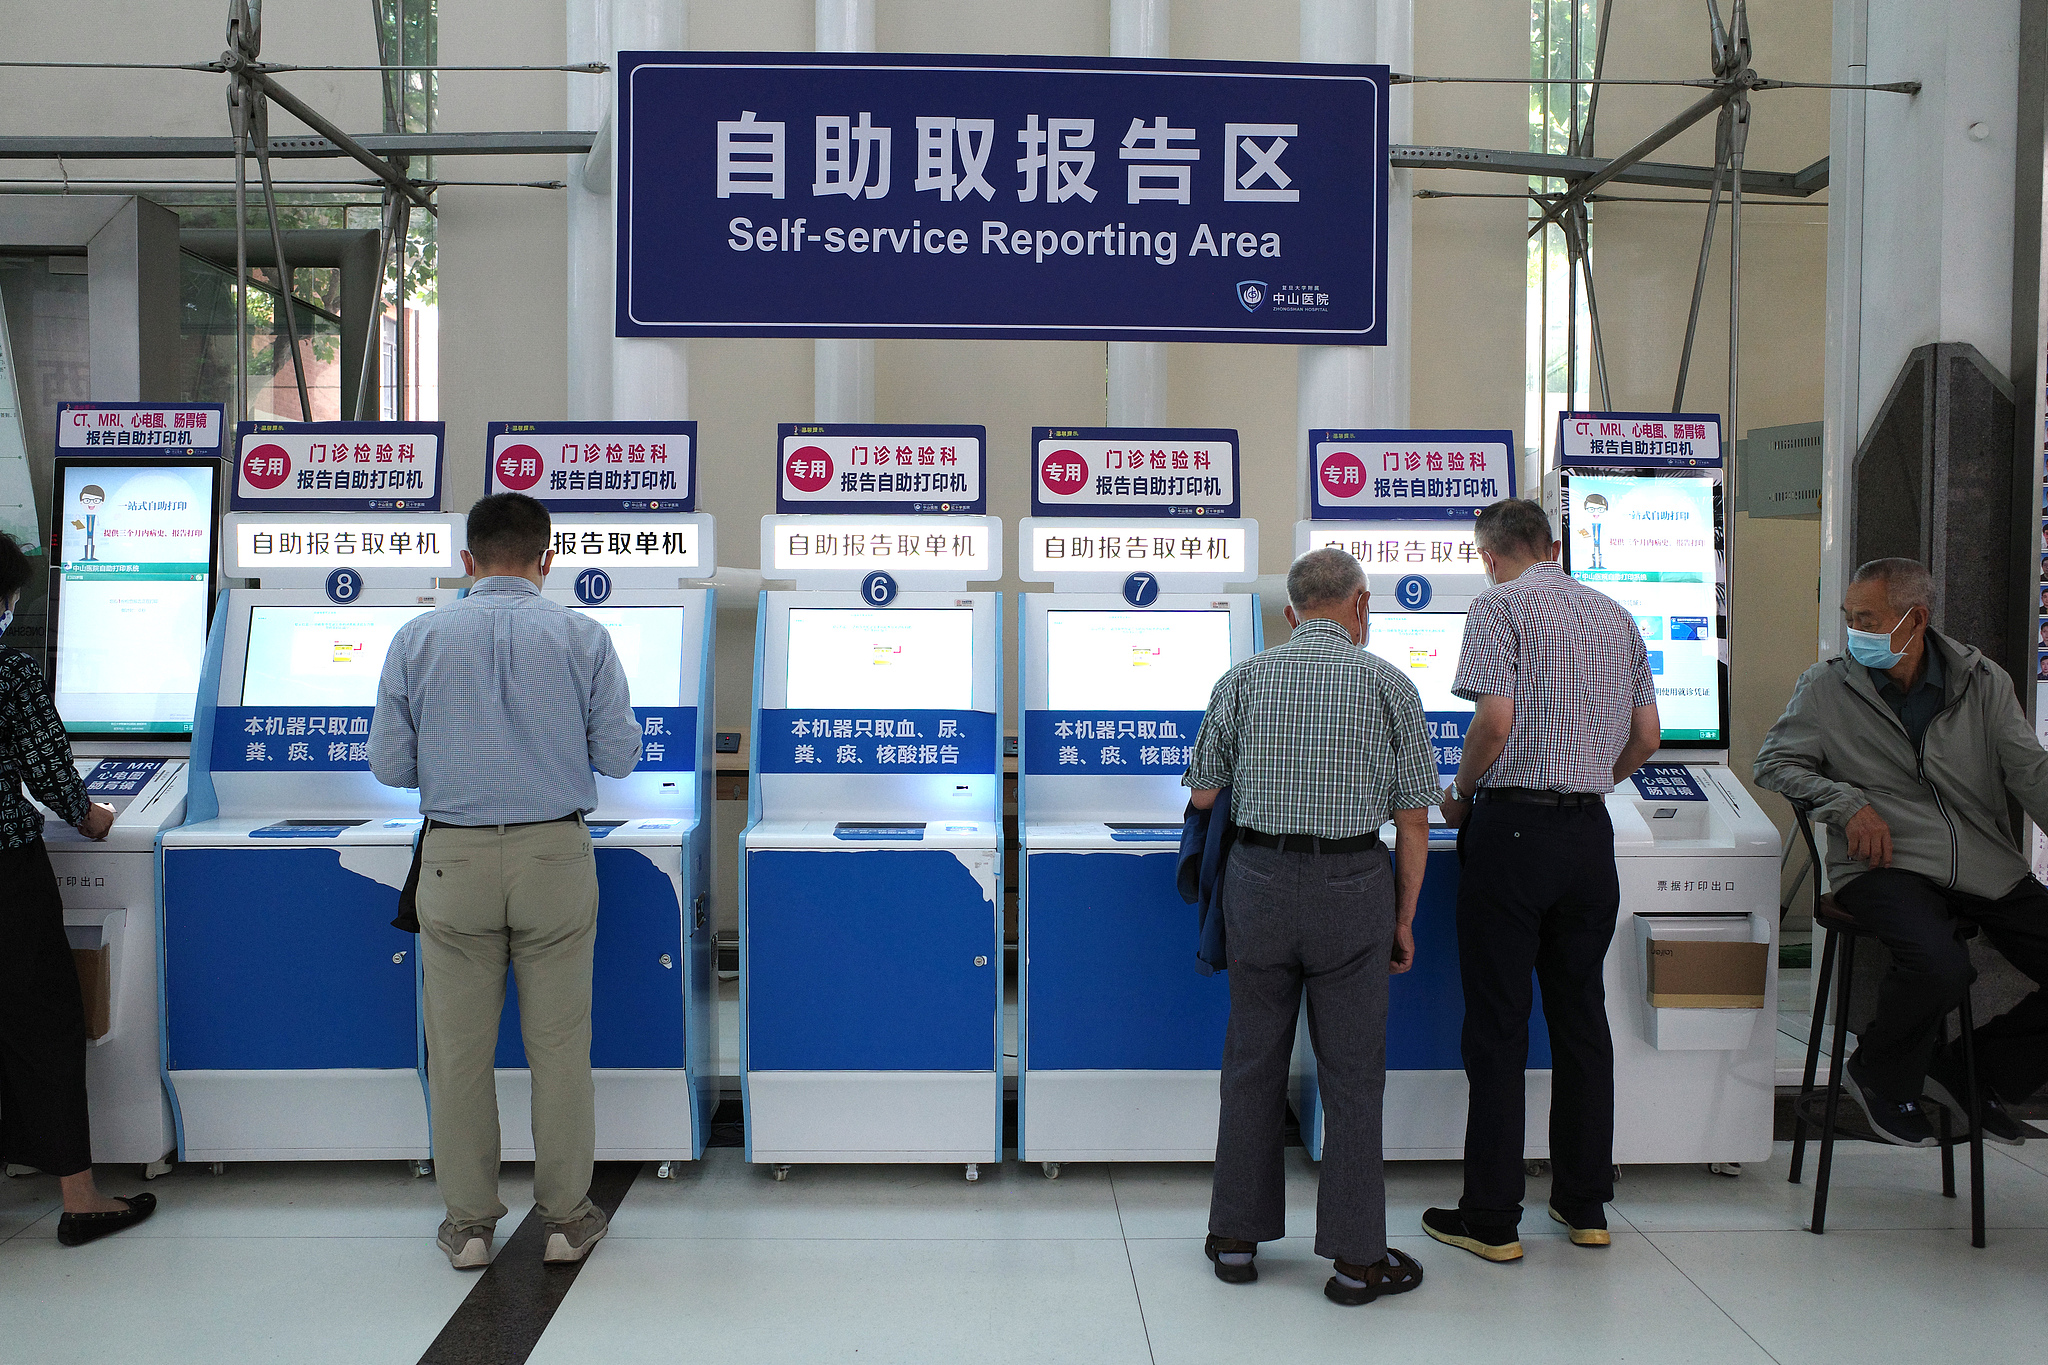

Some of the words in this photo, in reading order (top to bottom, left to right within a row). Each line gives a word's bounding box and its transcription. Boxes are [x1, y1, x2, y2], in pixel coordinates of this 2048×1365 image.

[715, 110, 1300, 205] 自助取报告区
[728, 217, 968, 254] Self-service
[981, 220, 1178, 265] Reporting
[1189, 223, 1281, 259] Area
[1273, 292, 1329, 306] 中山医院
[73, 413, 207, 429] CT、MRI、心电图、肠胃镜
[1575, 422, 1706, 440] CT、MRI、心电图、肠胃镜
[86, 430, 192, 446] 报告自助打印机
[1590, 439, 1693, 456] 报告自助打印机
[309, 443, 415, 463] 门诊检验科
[561, 443, 668, 464] 门诊检验科
[851, 445, 958, 466] 门诊检验科
[1105, 449, 1211, 470] 门诊检验科
[1383, 451, 1487, 472] 门诊检验科
[247, 457, 284, 476] 专用
[500, 457, 537, 477] 专用
[790, 459, 827, 479] 专用
[1045, 463, 1081, 482] 专用
[1324, 465, 1359, 485] 专用
[297, 469, 423, 490] 报告自助打印机
[550, 470, 677, 490] 报告自助打印机
[840, 472, 968, 493] 报告自助打印机
[1096, 476, 1221, 496] 报告自助打印机
[1374, 478, 1498, 498] 报告自助打印机
[118, 501, 187, 511] 一站式自助打印
[253, 531, 440, 555] 自助报告取单机
[553, 531, 687, 555] 报告取单机
[789, 533, 975, 557] 自助报告取单机
[1045, 536, 1230, 560] 自助报告取单机
[335, 573, 353, 599] 8
[580, 574, 607, 600] 10
[870, 576, 888, 602] 6
[1133, 577, 1150, 602] 7
[1405, 580, 1423, 605] 9
[244, 716, 369, 736] 本机器只取血
[644, 717, 672, 736] 尿、
[791, 718, 966, 738] 本机器只取血、尿、
[1054, 720, 1187, 740] 本机器只取血、
[245, 741, 369, 762] 粪、痰、核酸
[639, 742, 666, 761] 告
[794, 744, 960, 765] 粪、痰、核酸报告
[97, 771, 146, 780] 心电图
[99, 762, 123, 770] CT
[127, 762, 161, 770] MRI
[1654, 768, 1687, 776] MRI
[1641, 776, 1688, 786] 心电图
[1657, 880, 1735, 892] 票据打印出口
